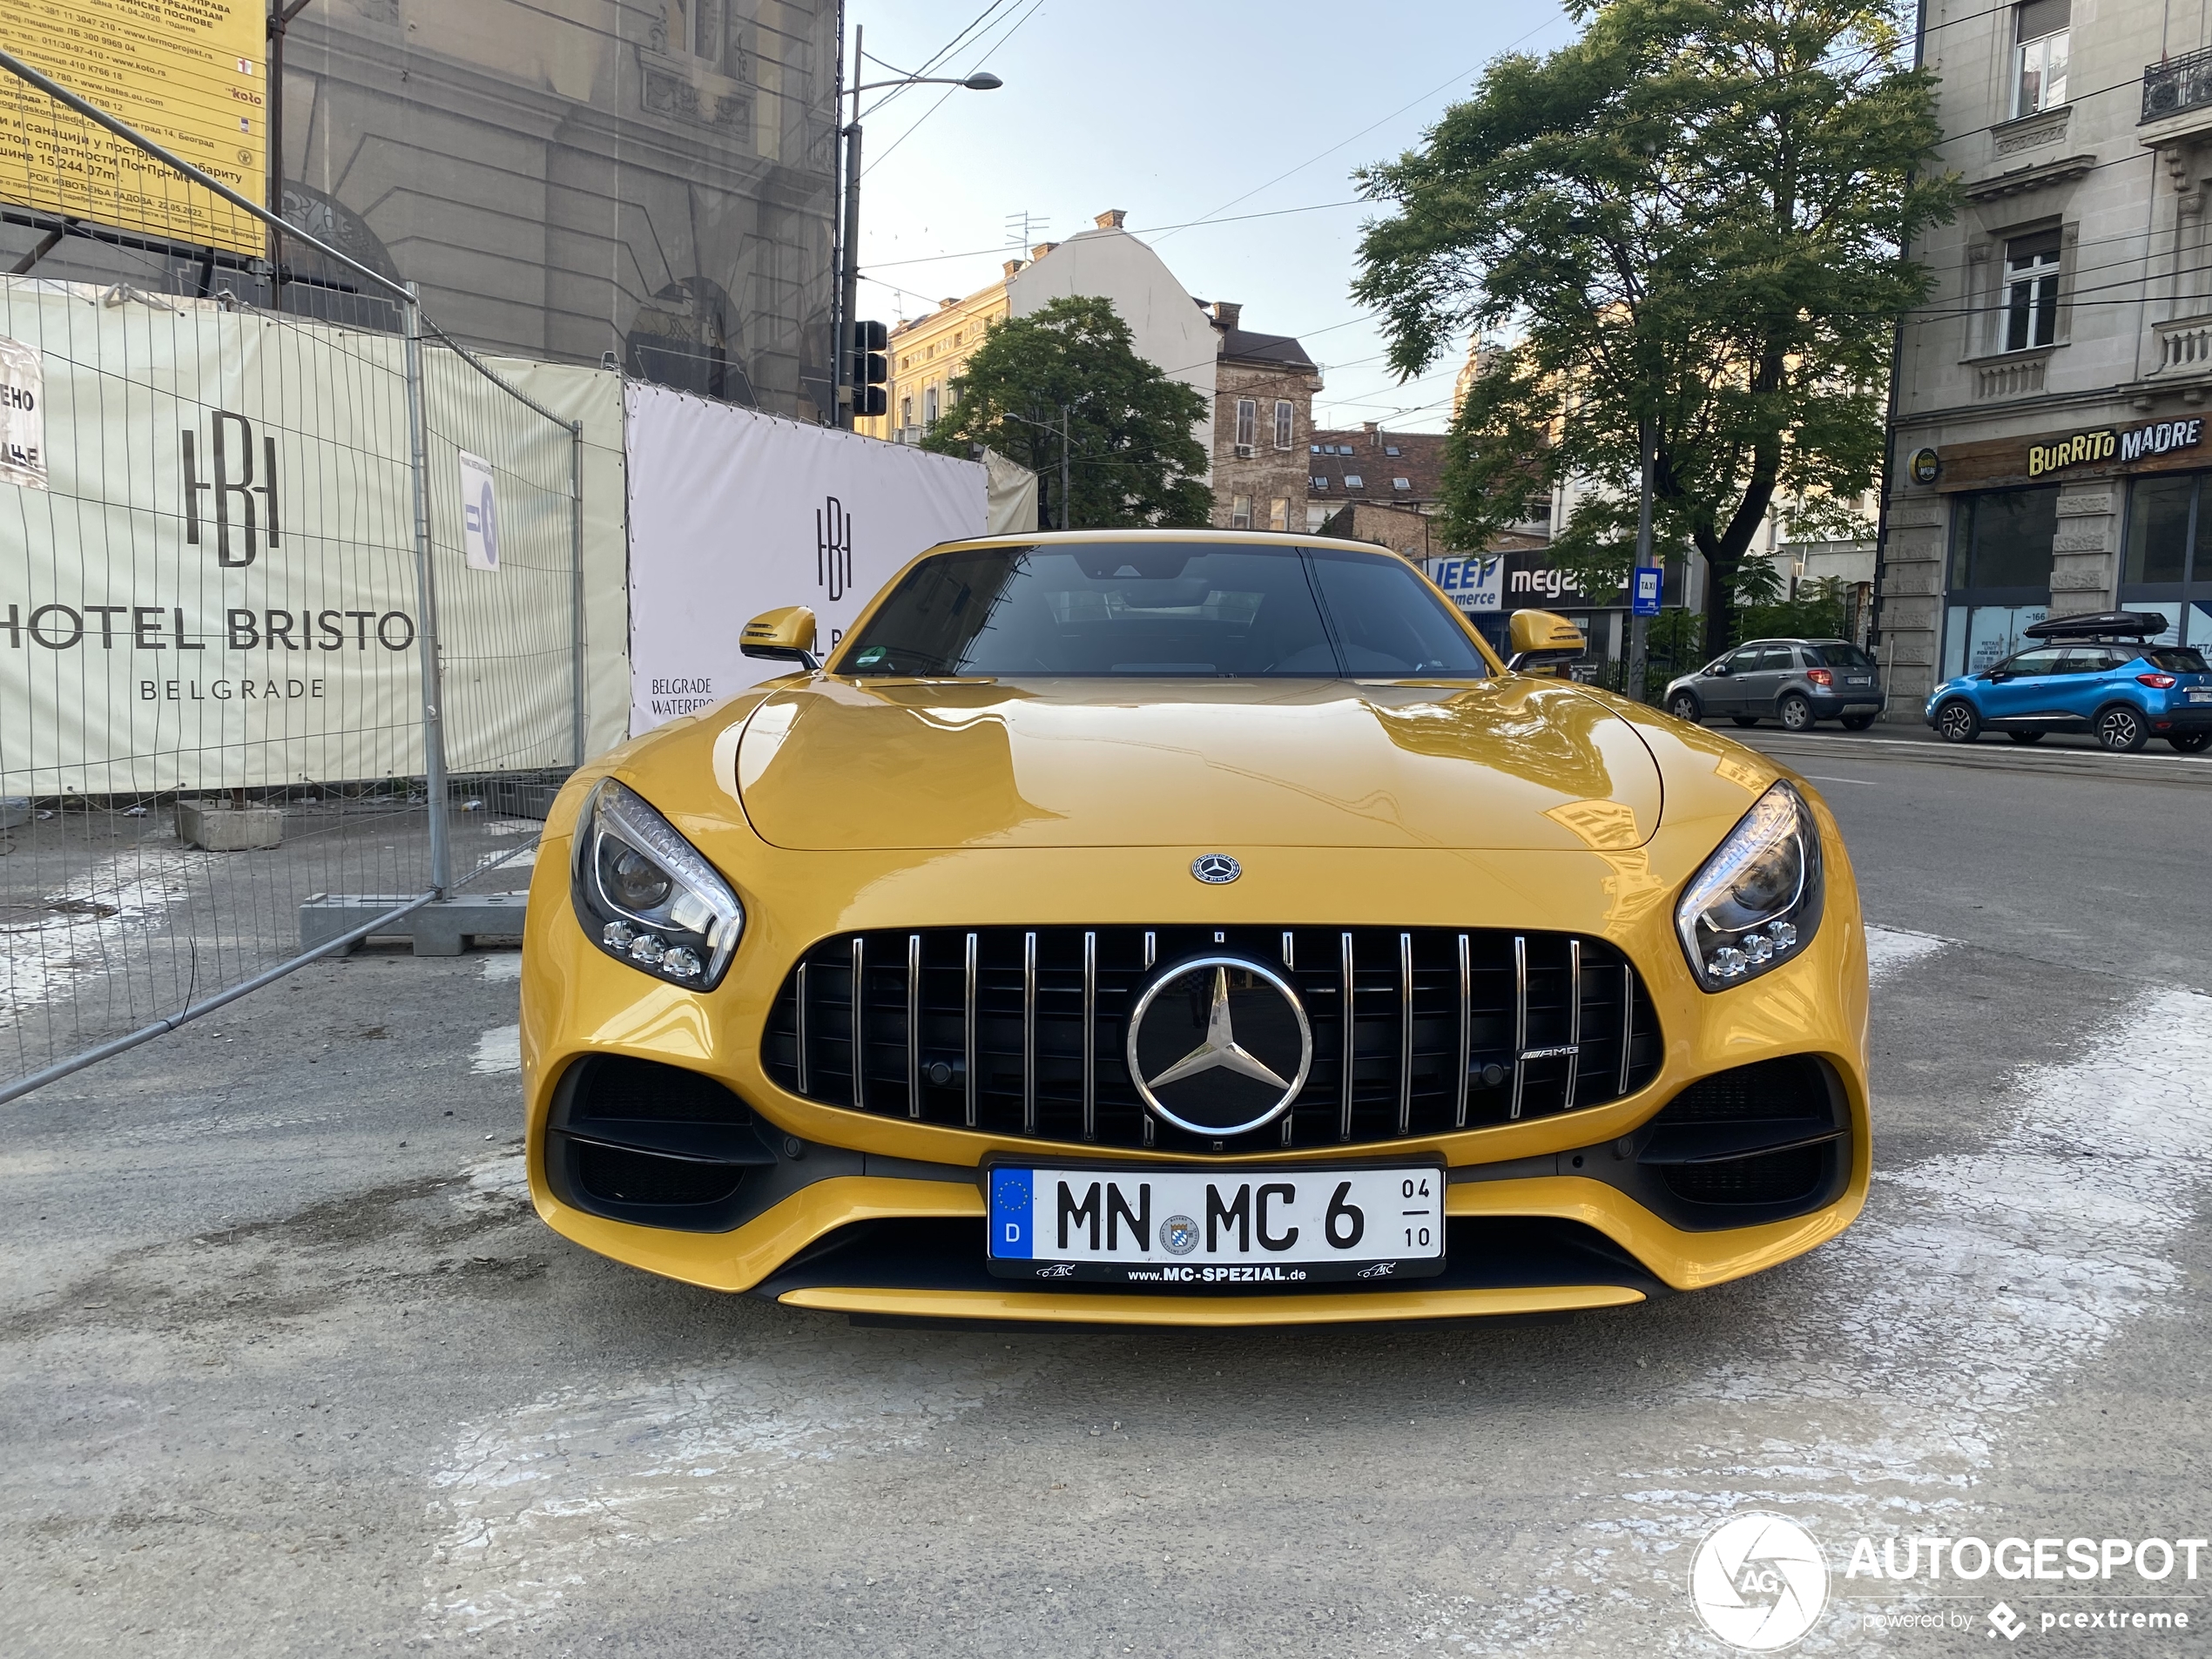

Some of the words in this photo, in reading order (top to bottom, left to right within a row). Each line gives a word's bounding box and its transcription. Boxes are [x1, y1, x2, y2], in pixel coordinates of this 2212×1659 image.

[99, 21, 116, 31] 210
[164, 8, 213, 29] ПОСЛОВЕ
[2121, 419, 2201, 462] MADRE
[1641, 581, 1656, 590] TAXI
[226, 607, 442, 652] BRISTO
[139, 678, 325, 701] BELGRADE
[651, 678, 712, 695] BELGRADE
[1539, 1046, 1579, 1058] AMG
[1402, 1178, 1430, 1198] 04
[1057, 1181, 1150, 1252] MN
[1206, 1183, 1299, 1252] MC
[1325, 1181, 1365, 1250] 6
[1006, 1223, 1020, 1243] D
[1405, 1227, 1430, 1247] 10
[1128, 1266, 1306, 1282] www.MC-SPEZIAL.de
